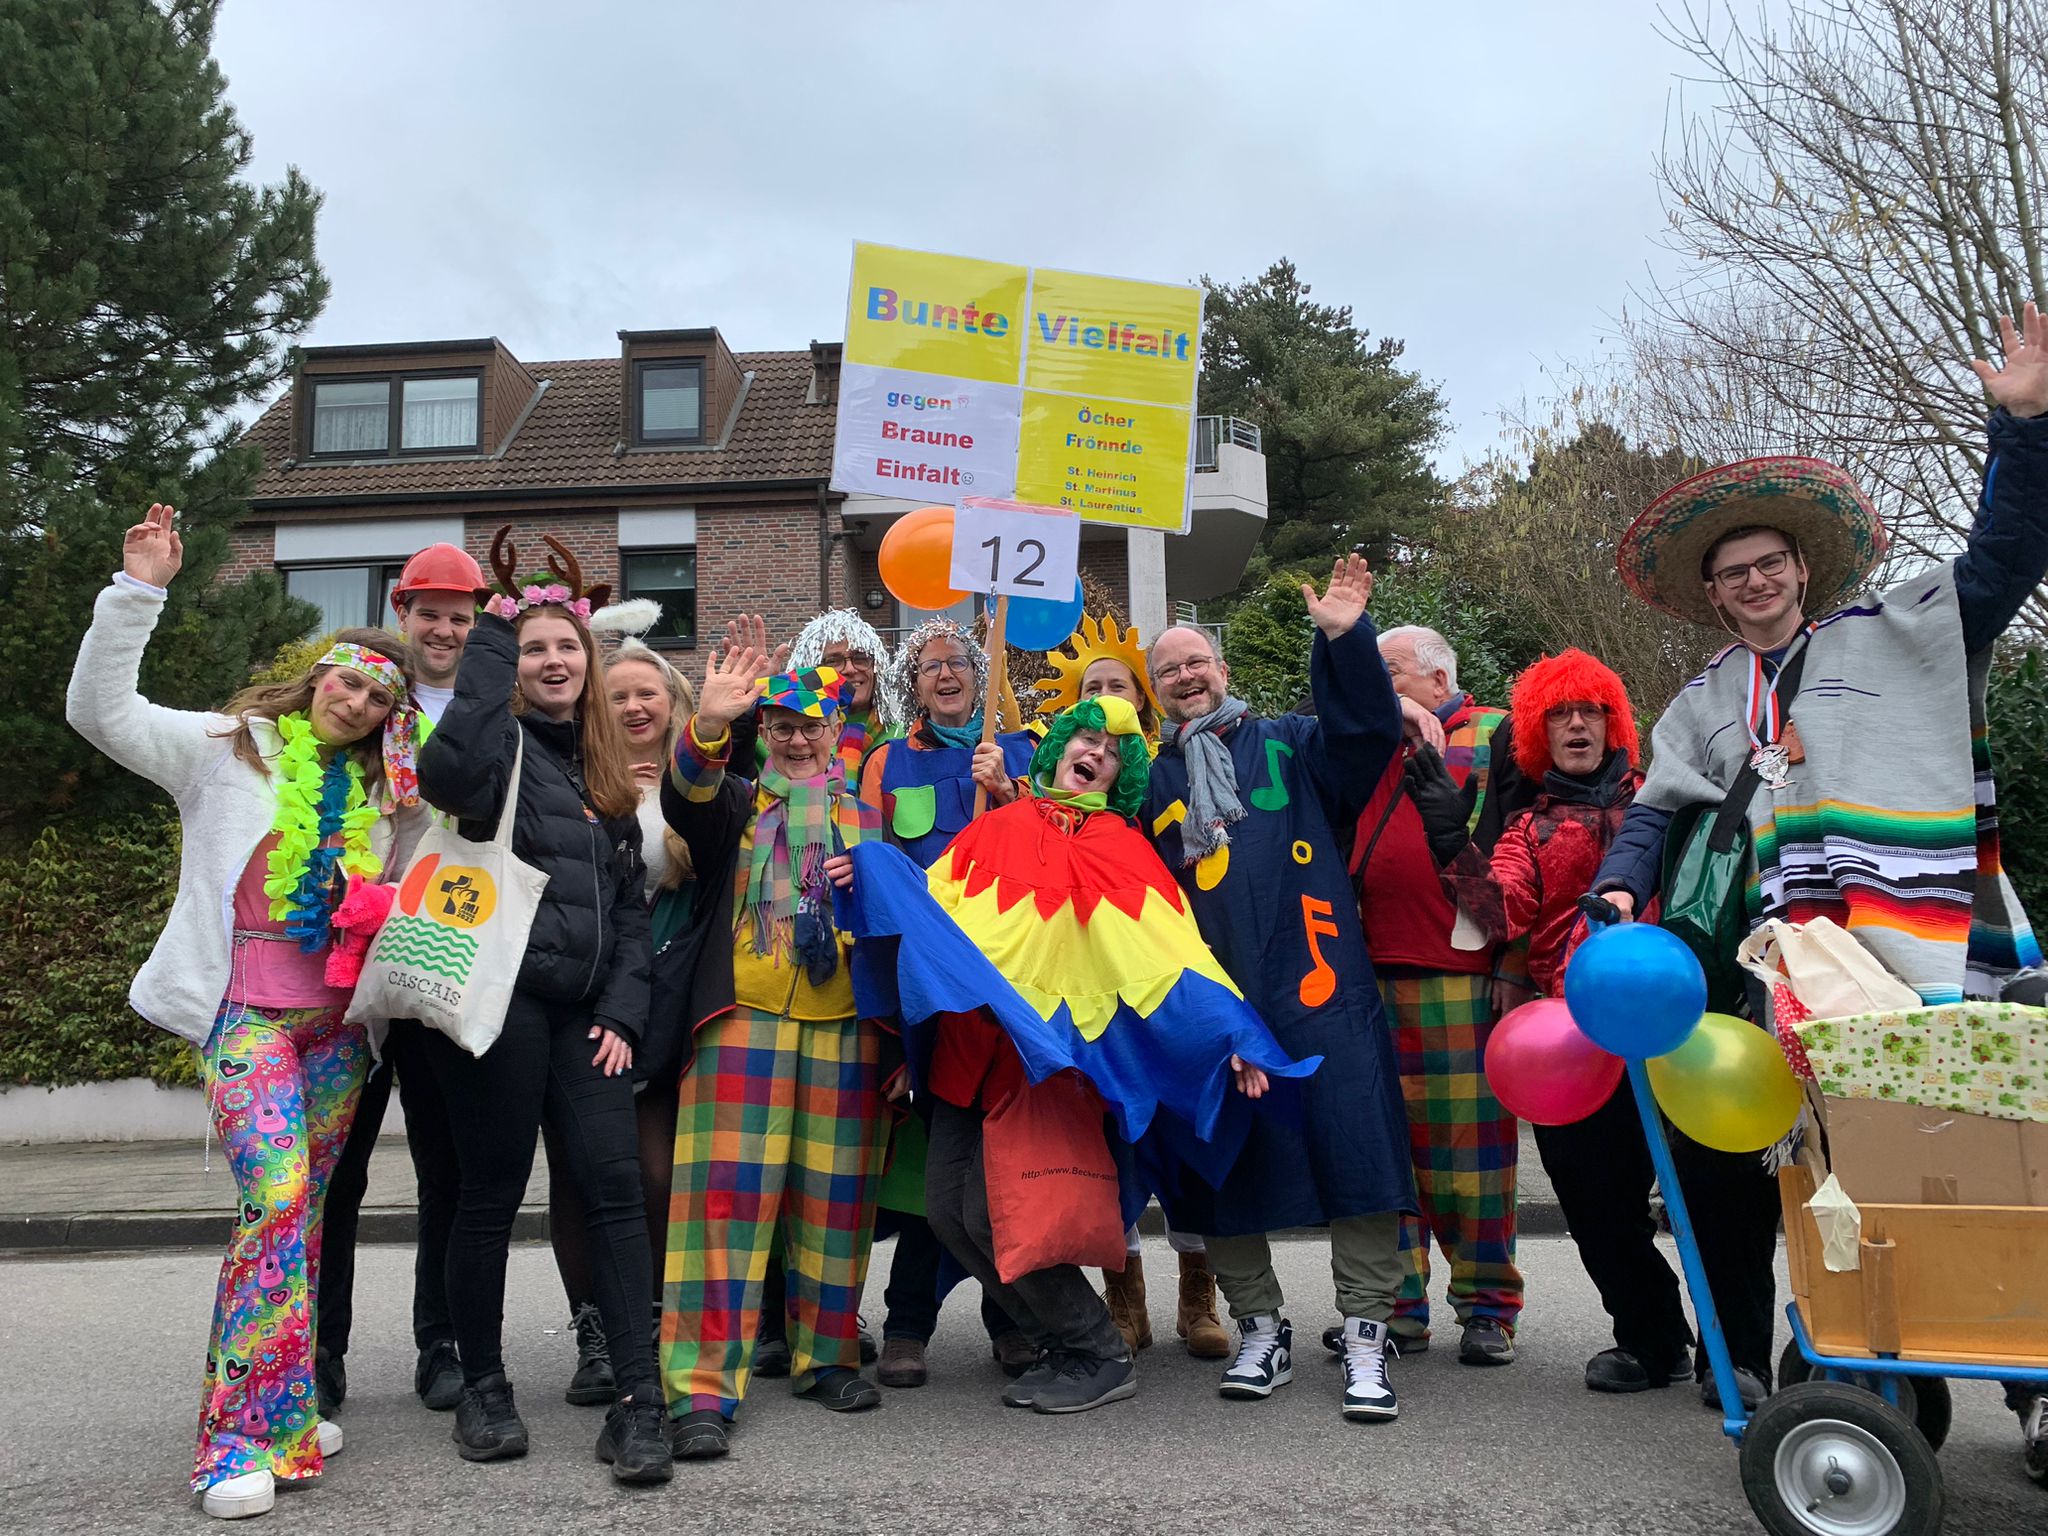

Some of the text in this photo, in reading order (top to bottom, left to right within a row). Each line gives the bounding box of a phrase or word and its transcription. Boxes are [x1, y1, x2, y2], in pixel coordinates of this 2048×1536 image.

[866, 286, 1191, 362] Bunte Vielfalt
[887, 391, 952, 411] gegen
[1078, 406, 1136, 428] Öcher
[881, 420, 974, 449] Braune
[1065, 433, 1143, 455] Frönnde
[876, 457, 960, 486] Einfalt
[1067, 466, 1137, 483] St. Heinrich
[1065, 481, 1137, 498] St. Martinus
[1060, 496, 1143, 514] St. Laurentius
[981, 535, 1046, 587] 12
[460, 901, 480, 915] JMJ
[388, 970, 461, 1007] CASCAIS
